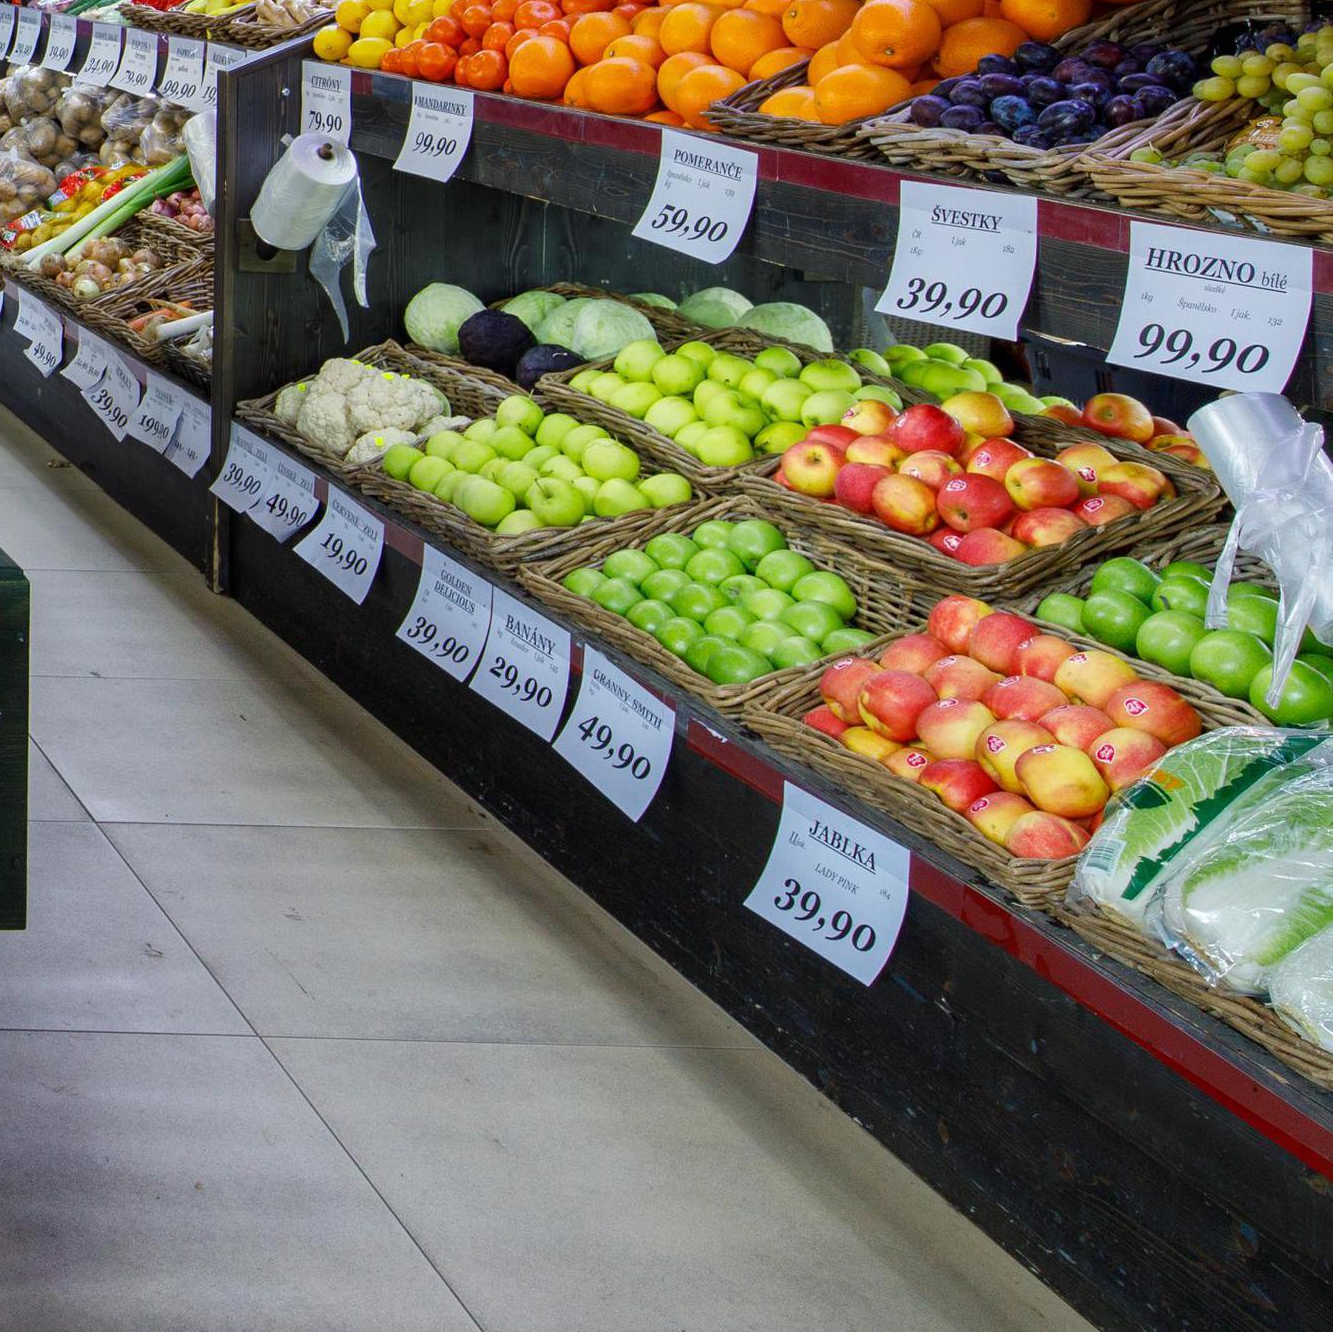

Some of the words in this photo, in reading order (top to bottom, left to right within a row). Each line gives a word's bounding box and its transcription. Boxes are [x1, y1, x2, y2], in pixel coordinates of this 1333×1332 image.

[162, 79, 197, 100] 99,90
[310, 75, 342, 93] CITRÓNY
[308, 110, 343, 134] 79,90
[416, 95, 467, 117] MANDARINKY
[412, 131, 458, 158] 99,90
[673, 149, 744, 179] POMERANČE
[650, 203, 729, 243] 59,90
[931, 204, 1004, 231] ŠVESTKY
[1144, 247, 1256, 285] HROZNO
[1260, 271, 1288, 291] bílé
[896, 277, 1009, 321] 39,90
[1177, 296, 1218, 315] Španělsko
[33, 341, 58, 368] 49,90
[1132, 323, 1271, 375] 99,90
[90, 388, 129, 429] 39,90
[223, 462, 262, 496] 39,90
[266, 493, 308, 528] 49,90
[320, 532, 368, 576] 19,90
[434, 579, 476, 615] DELICIOUS
[440, 568, 474, 596] GOLDEN
[407, 616, 470, 664] 39,90
[504, 613, 557, 656] BANÁNY
[489, 656, 553, 709] 29,90
[593, 668, 632, 703] GRANNY
[632, 698, 664, 730] SMITH
[578, 716, 651, 781] 49,90
[807, 818, 878, 872] JABLKA
[813, 862, 838, 884] LADY
[837, 876, 861, 896] PINK
[773, 877, 877, 953] 39,90
